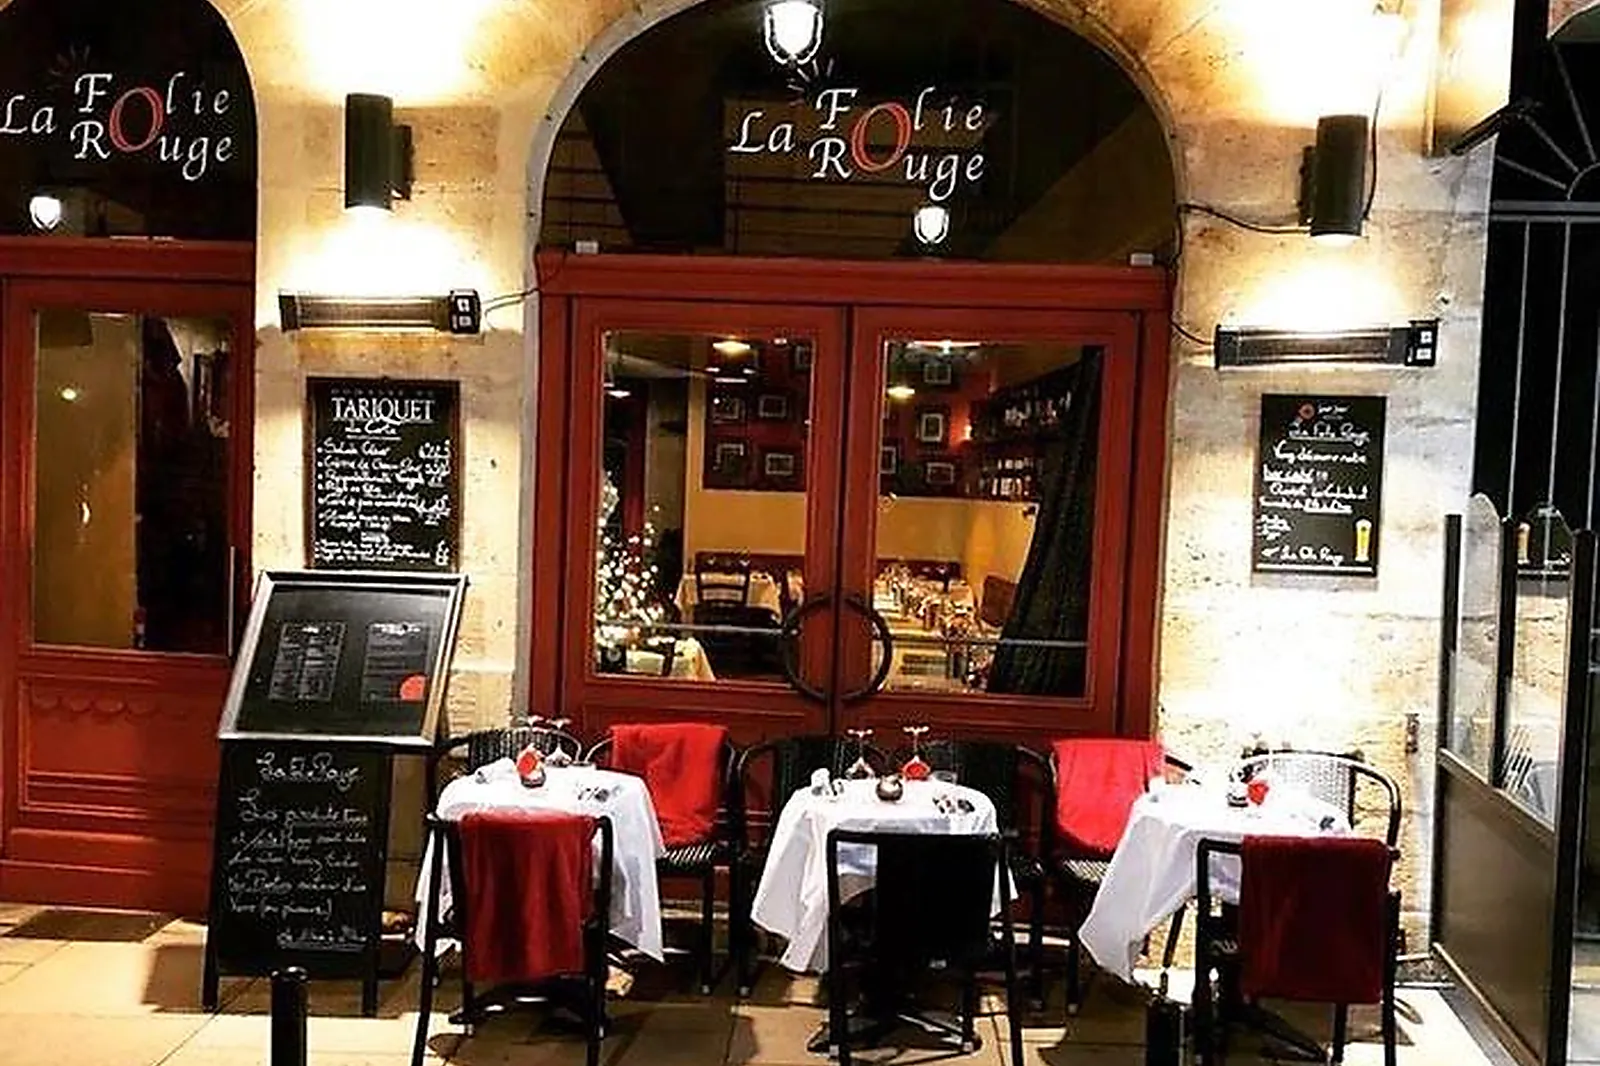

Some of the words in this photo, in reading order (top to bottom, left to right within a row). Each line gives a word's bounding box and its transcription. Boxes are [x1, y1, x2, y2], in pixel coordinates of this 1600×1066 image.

[0, 95, 56, 134] La
[728, 111, 796, 152] La
[331, 397, 435, 425] TARIQUET
